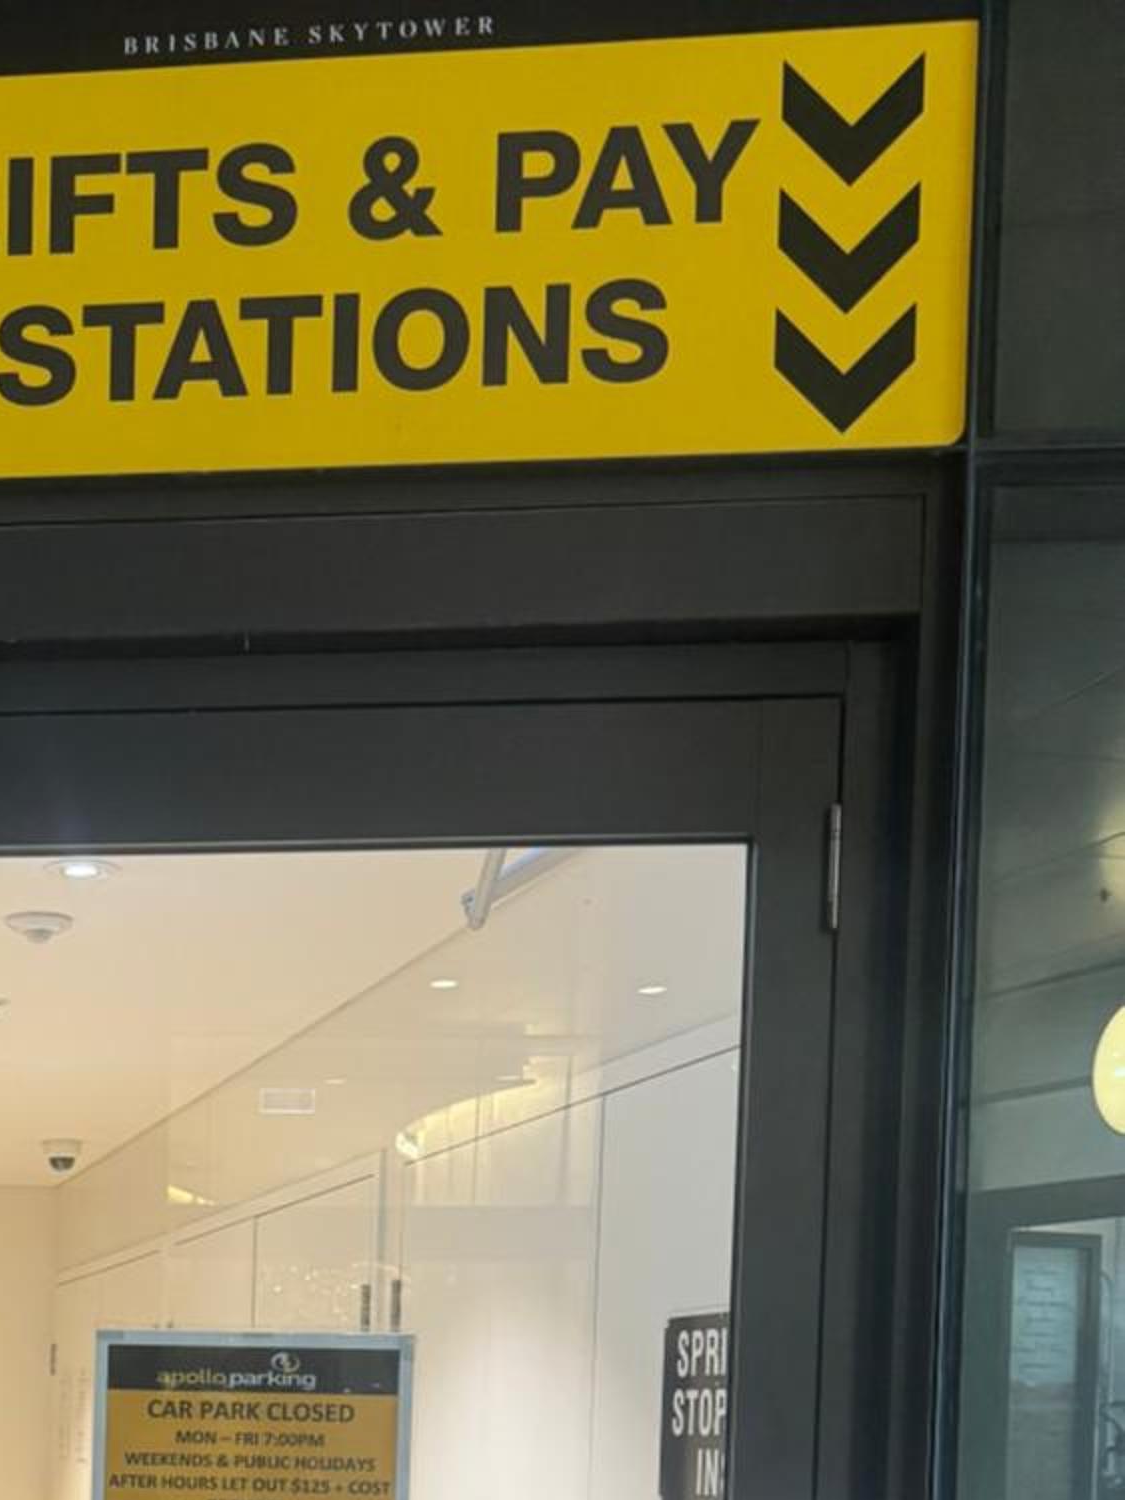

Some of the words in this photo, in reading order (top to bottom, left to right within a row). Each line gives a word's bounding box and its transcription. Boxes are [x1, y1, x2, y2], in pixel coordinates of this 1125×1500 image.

[123, 27, 292, 56] BRISBANE
[308, 14, 498, 48] SKYTOWER
[347, 135, 438, 242] &
[494, 118, 761, 234] PAY
[157, 1367, 228, 1389] apollo
[229, 1368, 317, 1390] parking
[147, 1399, 192, 1419] CAR
[200, 1401, 259, 1421] PARK
[266, 1403, 355, 1423] CLOSED
[175, 1430, 216, 1444] MON
[235, 1432, 261, 1446] FRI
[264, 1433, 325, 1447] 7:00PM
[124, 1452, 212, 1468] WEEKENDS
[216, 1454, 229, 1469] &
[235, 1455, 291, 1470] PUBLIC
[294, 1456, 376, 1471] HOLIDAYS
[109, 1476, 157, 1490] AFTER
[161, 1477, 217, 1491] HOURS
[222, 1477, 248, 1491] LET
[252, 1478, 286, 1493] OUT
[290, 1478, 330, 1494] $125
[348, 1480, 390, 1495] COST
